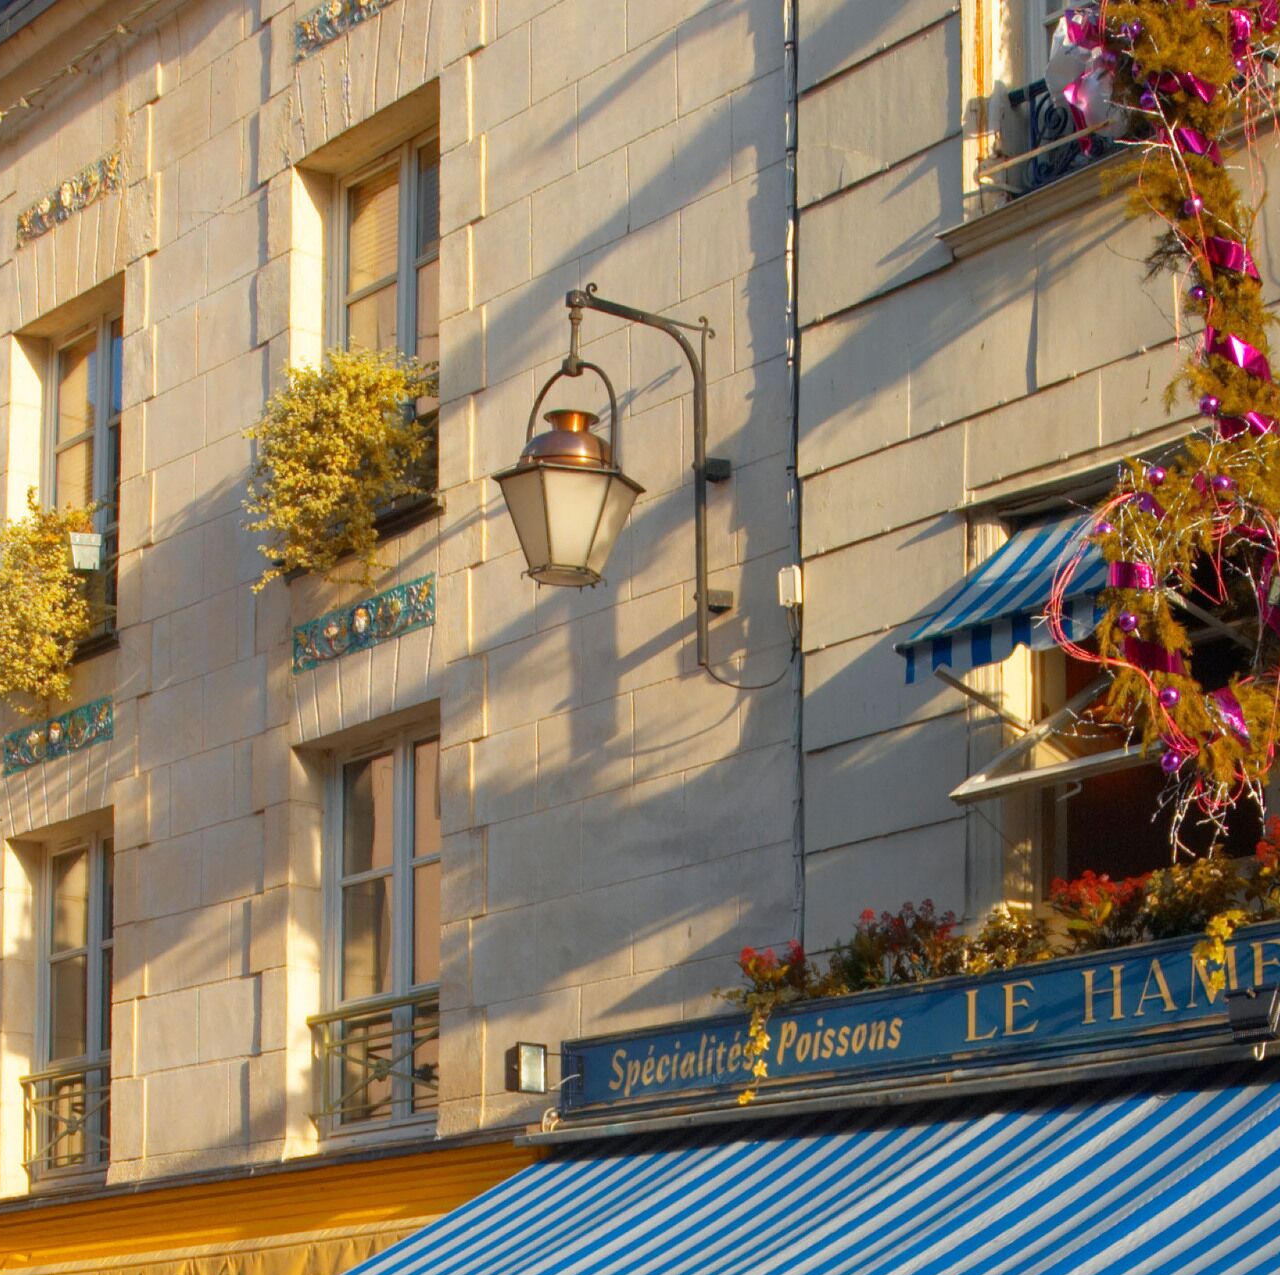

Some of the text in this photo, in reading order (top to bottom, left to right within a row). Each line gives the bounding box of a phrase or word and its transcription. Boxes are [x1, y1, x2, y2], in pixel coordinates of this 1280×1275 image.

[964, 979, 1039, 1044] LE
[608, 1016, 904, 1098] Spécialités Poissons
